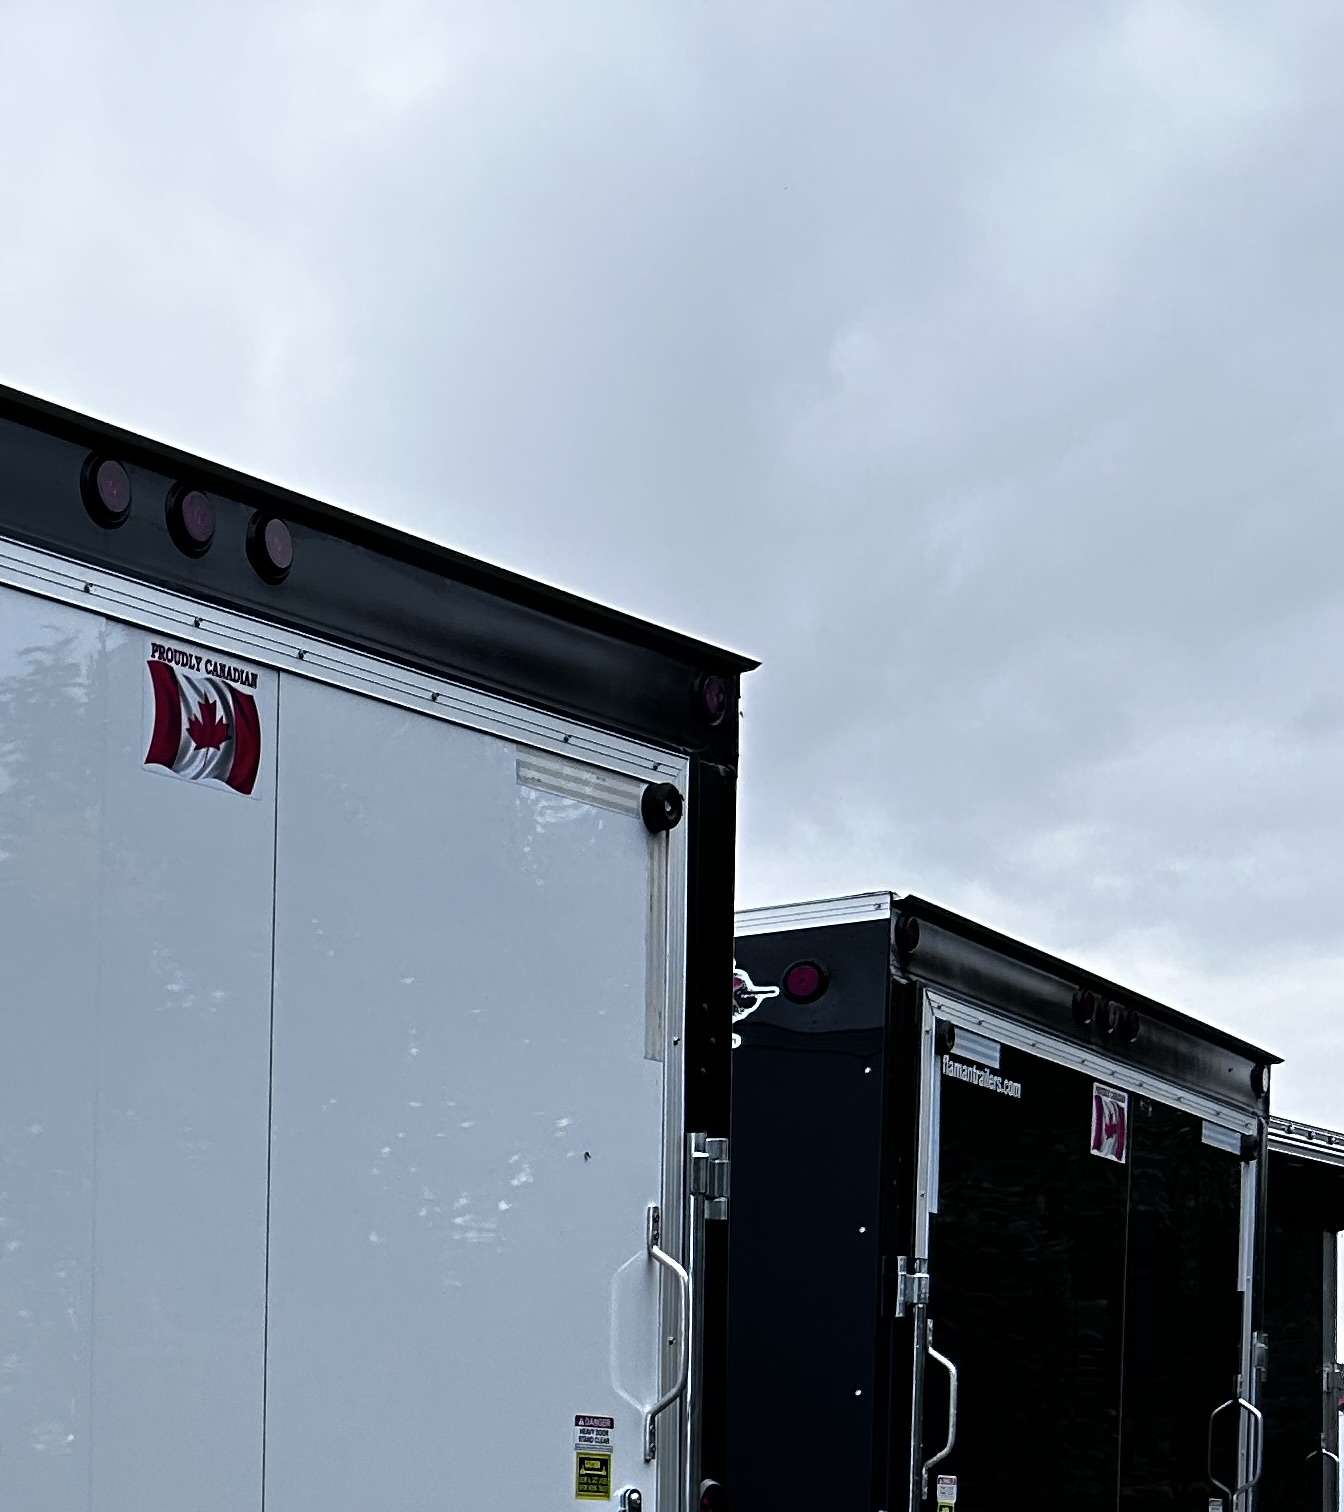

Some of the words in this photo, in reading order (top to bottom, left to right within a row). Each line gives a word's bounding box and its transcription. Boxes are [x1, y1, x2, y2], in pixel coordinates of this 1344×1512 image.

[150, 643, 202, 673] PROUDLY
[204, 658, 258, 689] CANADIAN
[942, 1054, 1022, 1099] flamantrailers.com
